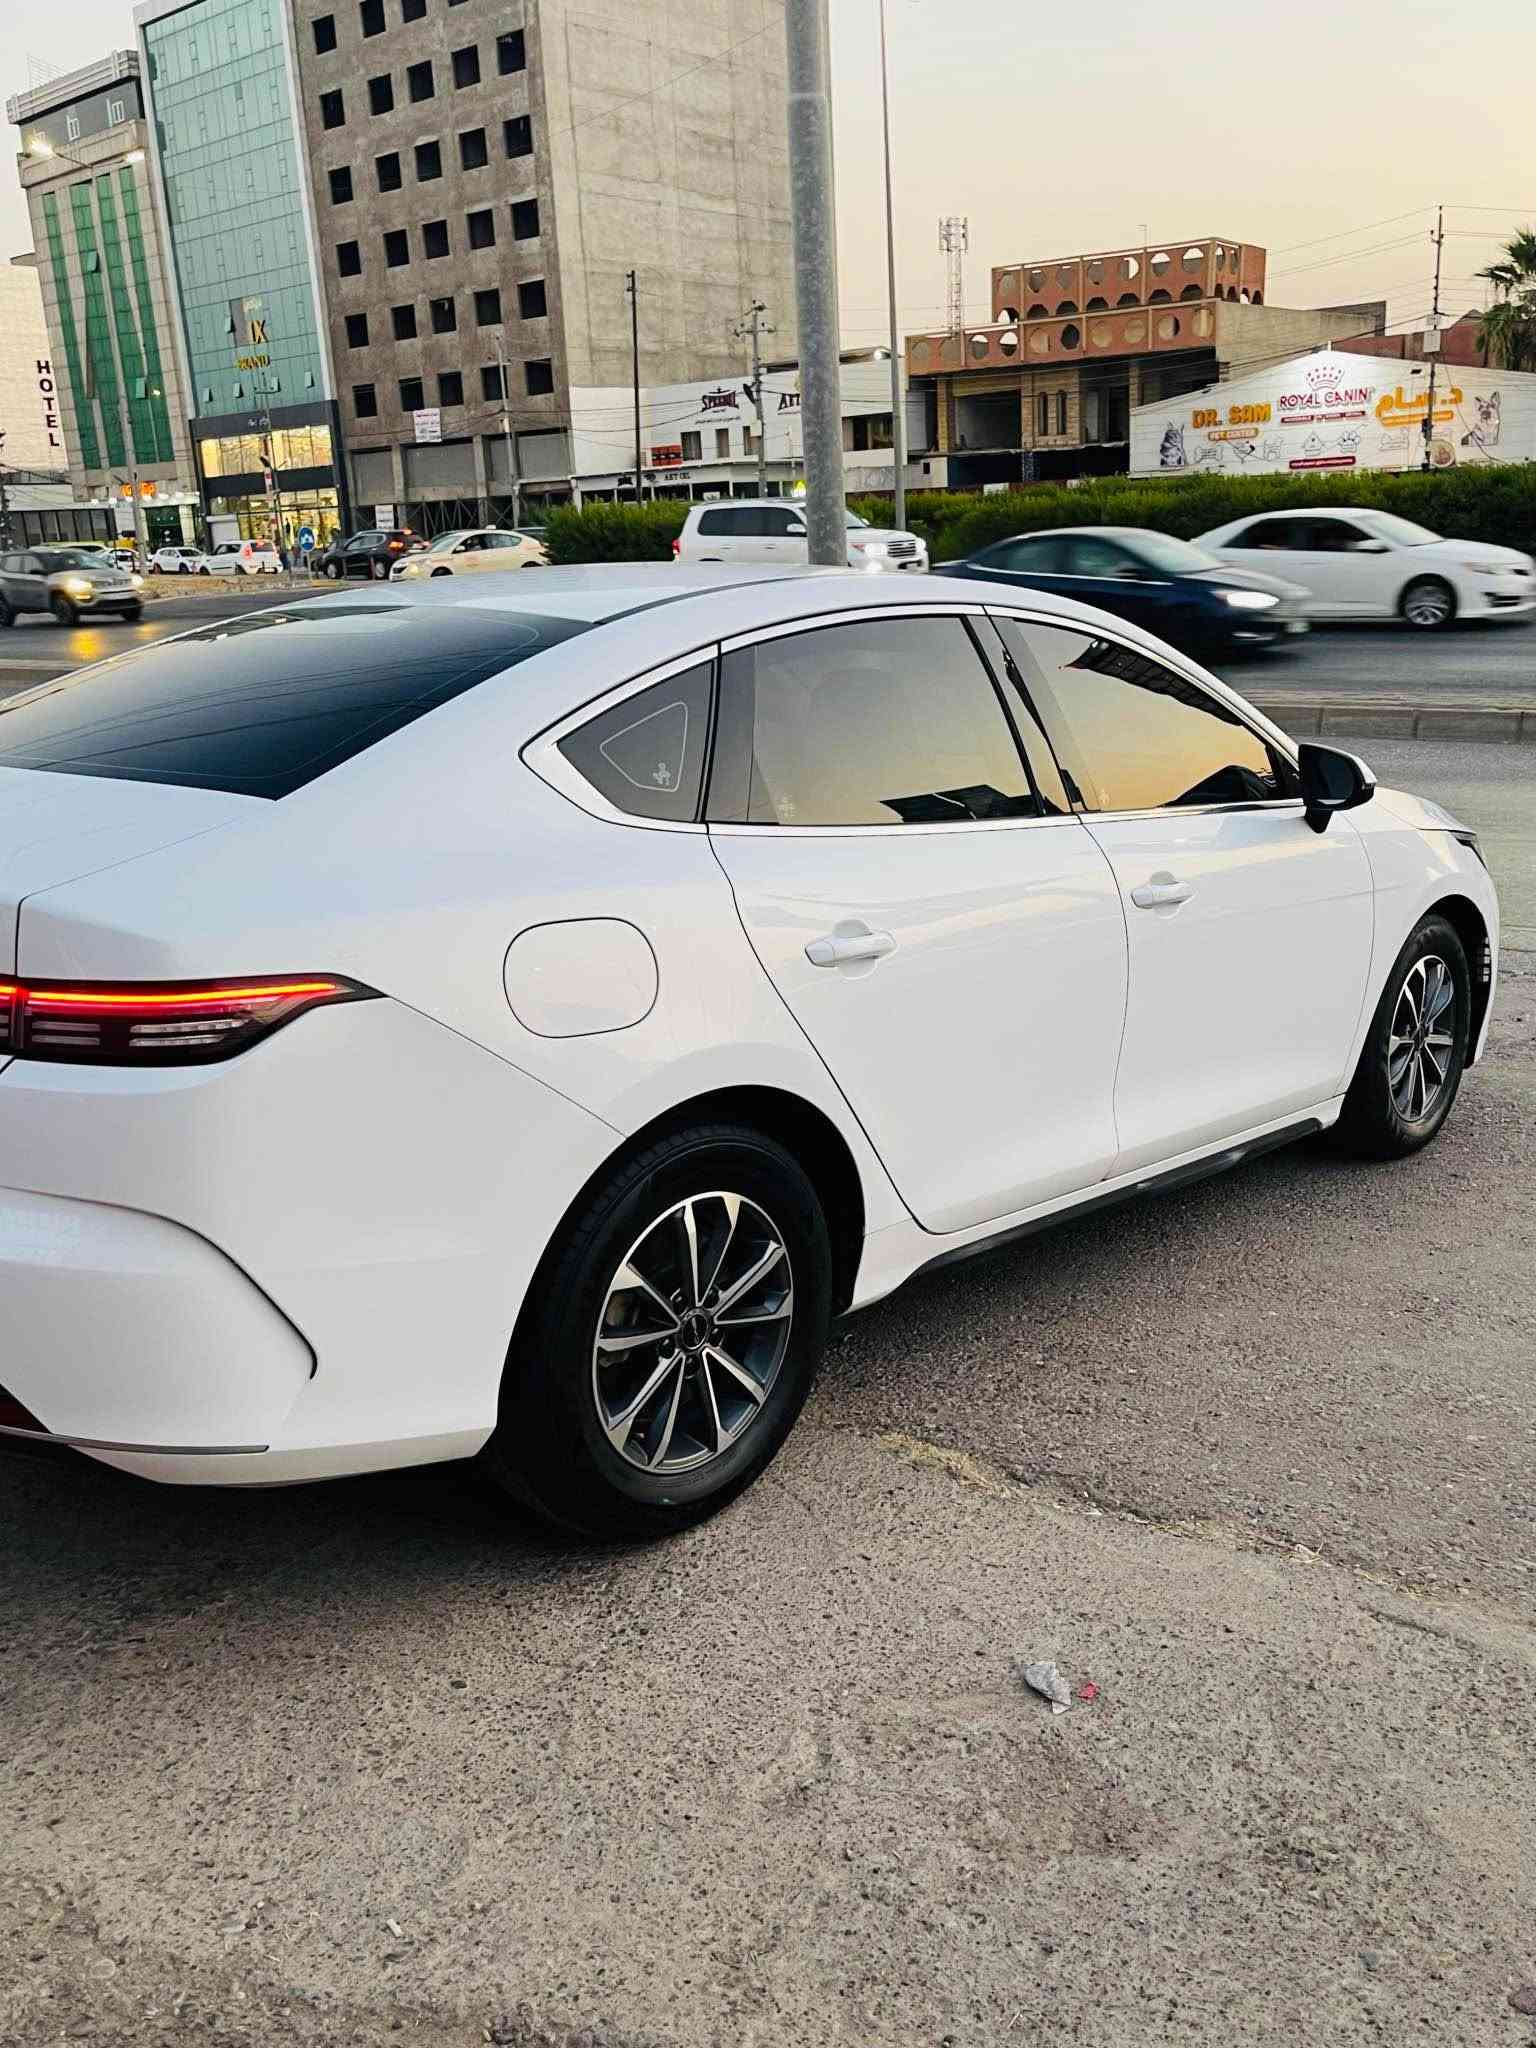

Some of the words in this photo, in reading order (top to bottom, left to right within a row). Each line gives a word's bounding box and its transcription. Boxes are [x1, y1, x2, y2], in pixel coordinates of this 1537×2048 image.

[36, 359, 60, 447] HOTEL
[1280, 392, 1321, 407] ROYAL
[1324, 387, 1368, 404] CANIN
[1229, 403, 1272, 425] SAM
